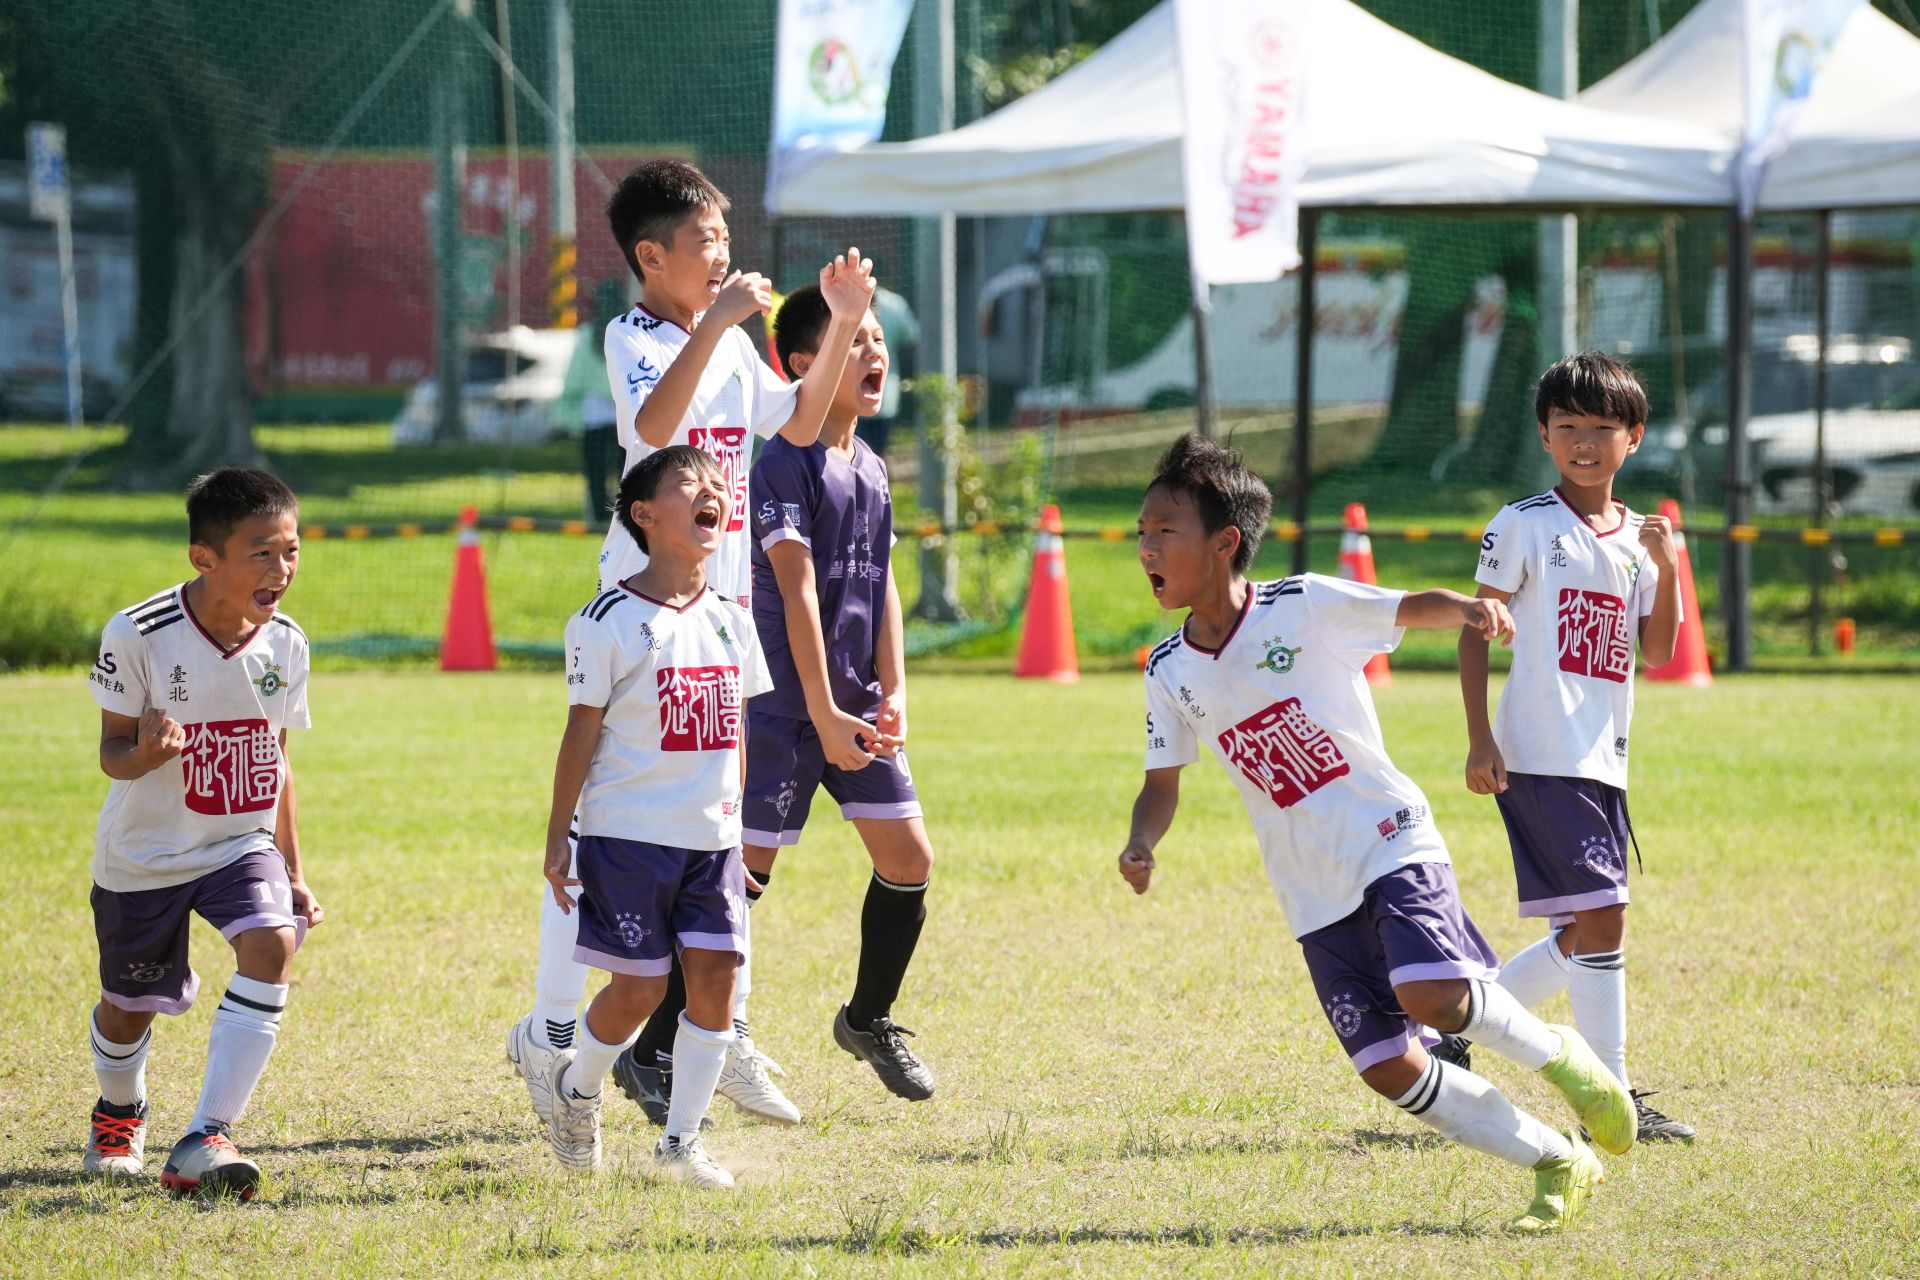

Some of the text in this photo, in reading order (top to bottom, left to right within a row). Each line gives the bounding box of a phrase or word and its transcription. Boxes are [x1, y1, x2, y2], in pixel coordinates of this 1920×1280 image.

[1231, 78, 1292, 241] YAMAHA
[1550, 534, 1567, 568] 臺北
[639, 621, 662, 652] 臺北
[169, 664, 188, 702] 臺北
[1179, 685, 1206, 720] 臺北
